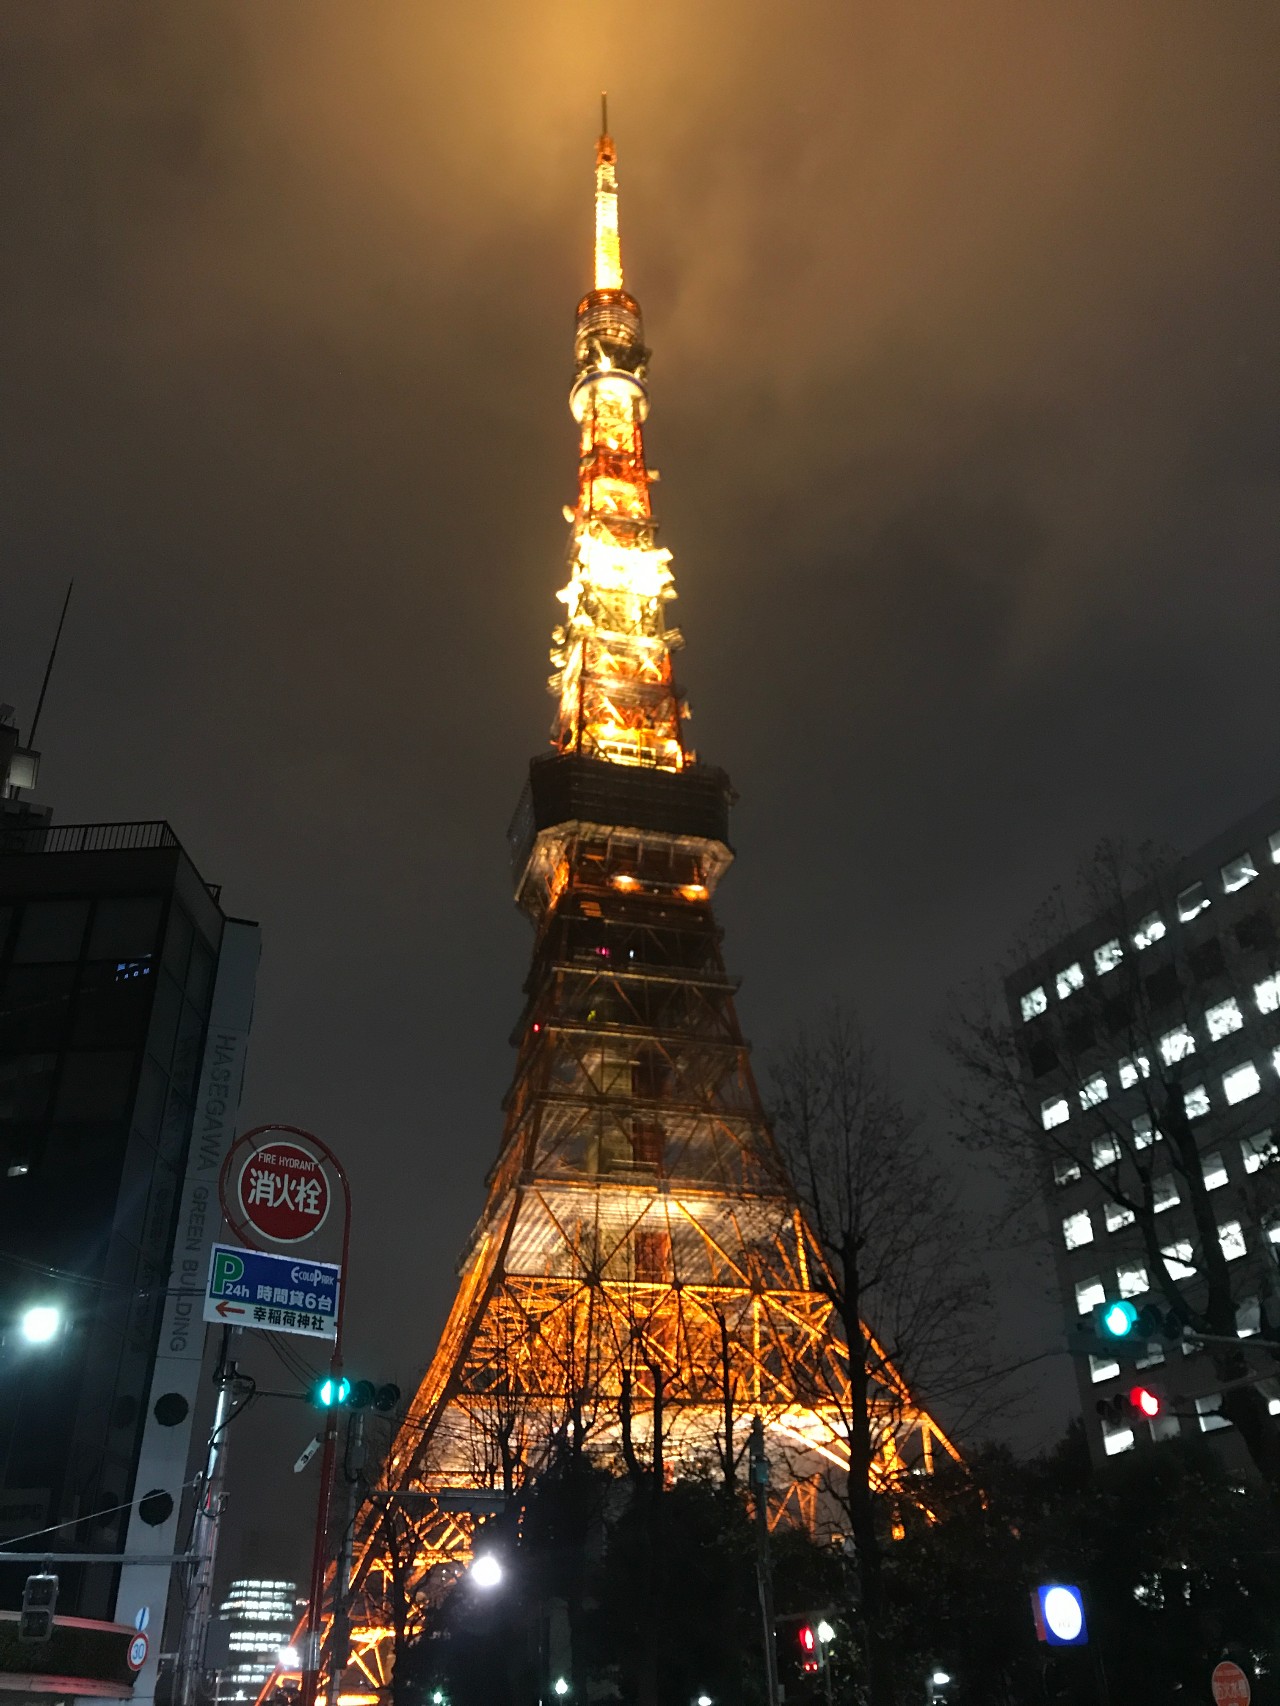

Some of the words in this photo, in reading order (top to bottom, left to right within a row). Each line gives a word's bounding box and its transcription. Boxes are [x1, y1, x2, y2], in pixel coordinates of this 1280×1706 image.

[197, 1034, 236, 1170] HASEGAWA
[258, 1152, 277, 1165] FIRE
[278, 1156, 315, 1172] HYDRANT
[248, 1168, 322, 1215] 消火栓
[186, 1186, 209, 1250] GREEN
[212, 1251, 244, 1295] P
[224, 1281, 250, 1298] 24h
[256, 1284, 332, 1312] 時間貸6台
[253, 1305, 325, 1331] 幸稲荷神社
[133, 1643, 146, 1660] 30
